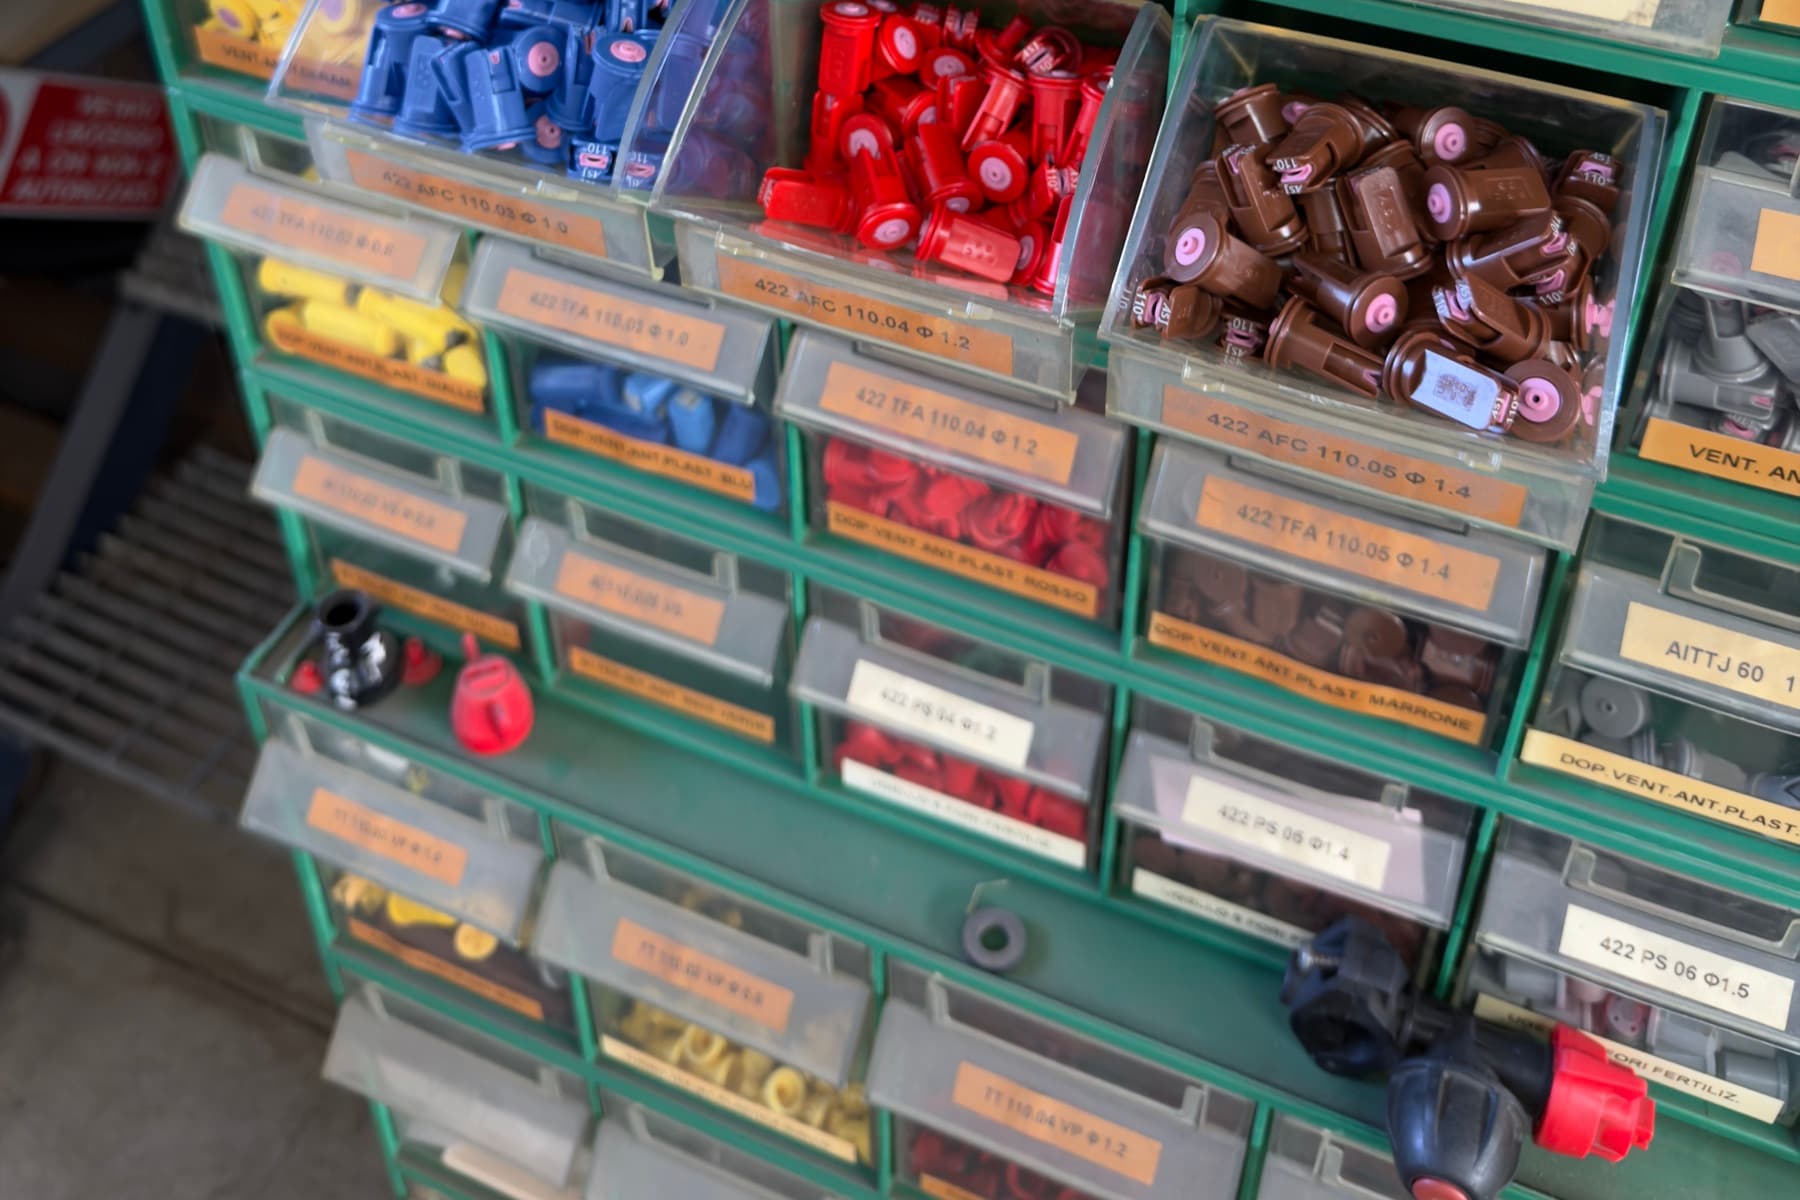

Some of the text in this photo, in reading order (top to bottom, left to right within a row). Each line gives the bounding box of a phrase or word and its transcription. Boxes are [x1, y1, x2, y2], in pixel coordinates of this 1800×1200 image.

[755, 277, 790, 298] 422
[844, 305, 909, 333] 110.04
[941, 330, 970, 351] 1.2
[856, 386, 884, 409] 422
[891, 396, 925, 422] TFA
[931, 408, 986, 438] 110.04
[1013, 434, 1039, 456] 1.2
[1206, 412, 1249, 436] 422
[1257, 425, 1307, 454] AFC
[1317, 444, 1397, 479] 110.05
[1435, 477, 1471, 499] 1.4
[1689, 443, 1758, 474] VENT.
[1236, 504, 1272, 528] 422
[1280, 515, 1318, 543] TFA
[1325, 529, 1390, 563] 110.05
[1420, 556, 1452, 580] 1.4
[1665, 640, 1731, 674] AITTJ
[1737, 661, 1764, 683] 60
[1368, 694, 1473, 732] MARRONE
[1217, 805, 1249, 828] 422
[1253, 818, 1278, 836] PS
[1599, 936, 1635, 960] 422
[1640, 949, 1667, 972] PS
[1674, 960, 1697, 981] 06
[1652, 1064, 1741, 1104] FERTILIZ.
